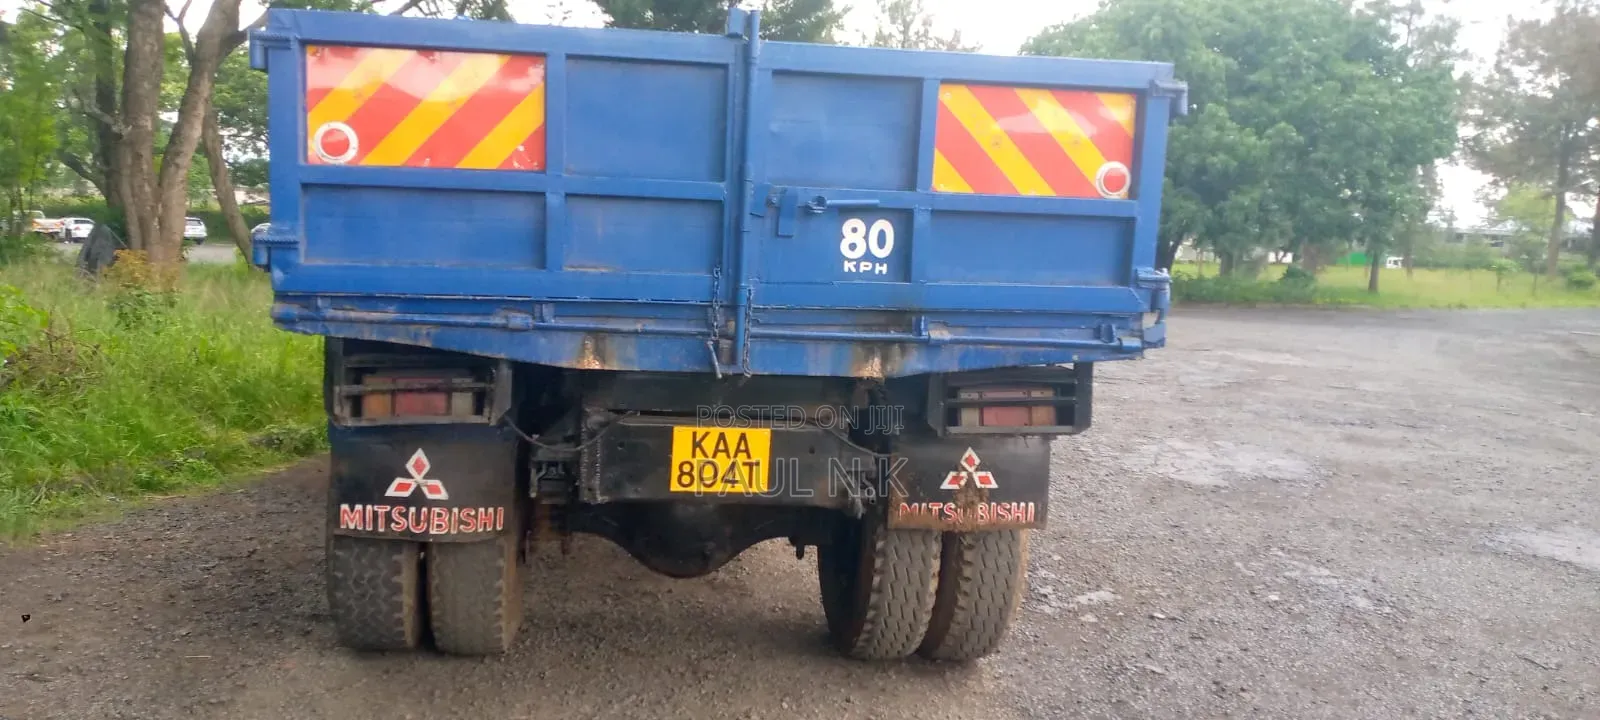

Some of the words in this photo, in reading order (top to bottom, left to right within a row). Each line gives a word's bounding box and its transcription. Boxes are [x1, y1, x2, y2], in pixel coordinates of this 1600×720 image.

[840, 218, 895, 259] 80
[843, 260, 888, 275] KPH
[691, 431, 753, 460] KAA
[676, 460, 760, 489] 804T
[339, 503, 505, 535] MITSUBISHI
